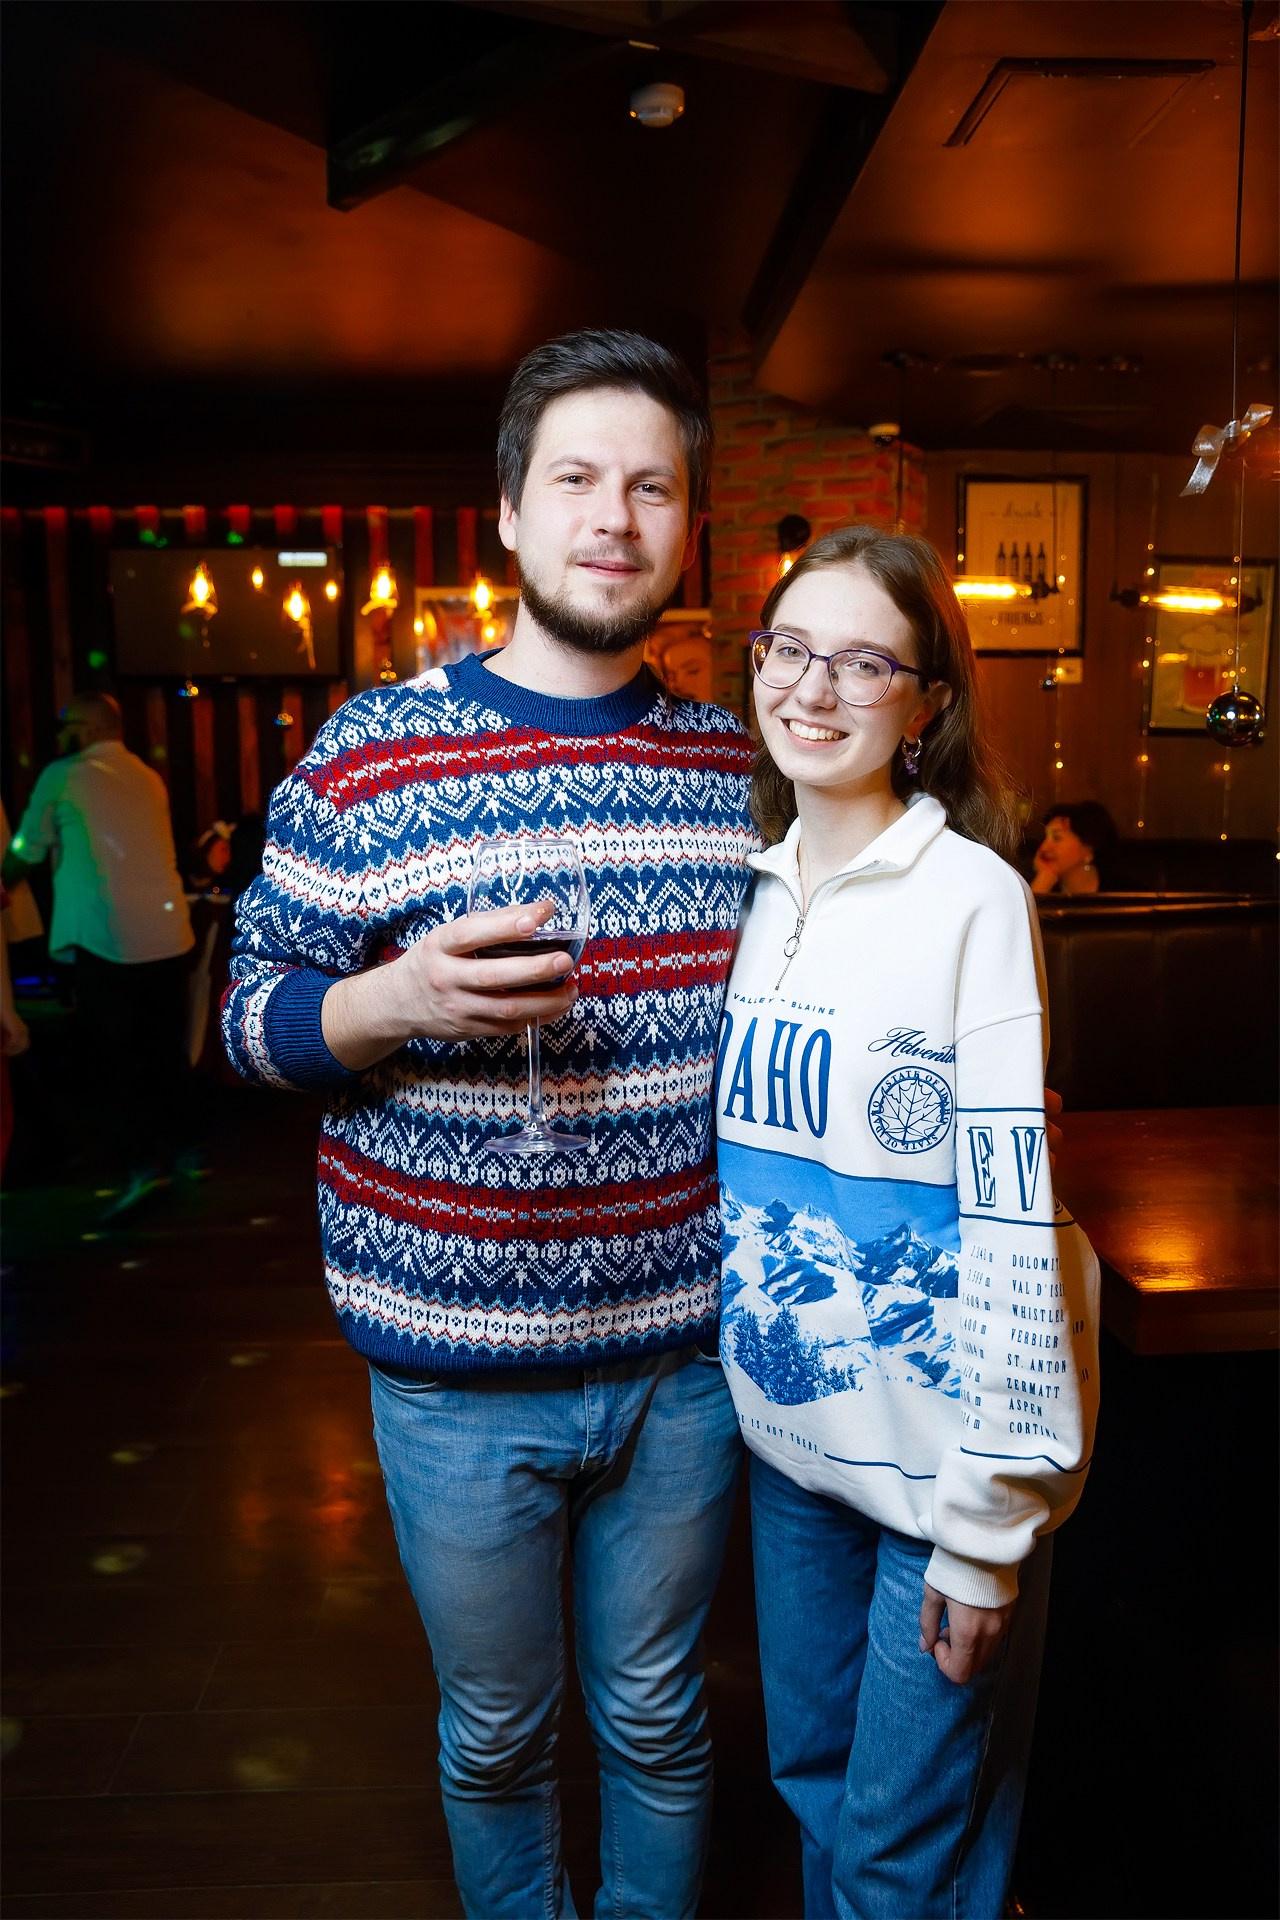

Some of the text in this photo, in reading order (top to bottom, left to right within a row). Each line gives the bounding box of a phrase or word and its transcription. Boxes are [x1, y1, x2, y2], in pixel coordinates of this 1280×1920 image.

[733, 992, 775, 1004] VALLEY
[791, 1001, 836, 1016] BLAINE
[885, 1070, 921, 1088] STATE
[925, 1074, 940, 1085] OF
[1012, 1279, 1030, 1295] VAL
[1010, 1328, 1059, 1349] VERBIER
[1007, 1353, 1024, 1369] ST.
[1029, 1358, 1067, 1374] ANTON
[1006, 1377, 1060, 1399] ZERMATT
[1009, 1397, 1043, 1418] ASPEN
[751, 1418, 760, 1429] IS
[766, 1424, 783, 1438] OUT
[789, 1432, 818, 1454] THERE
